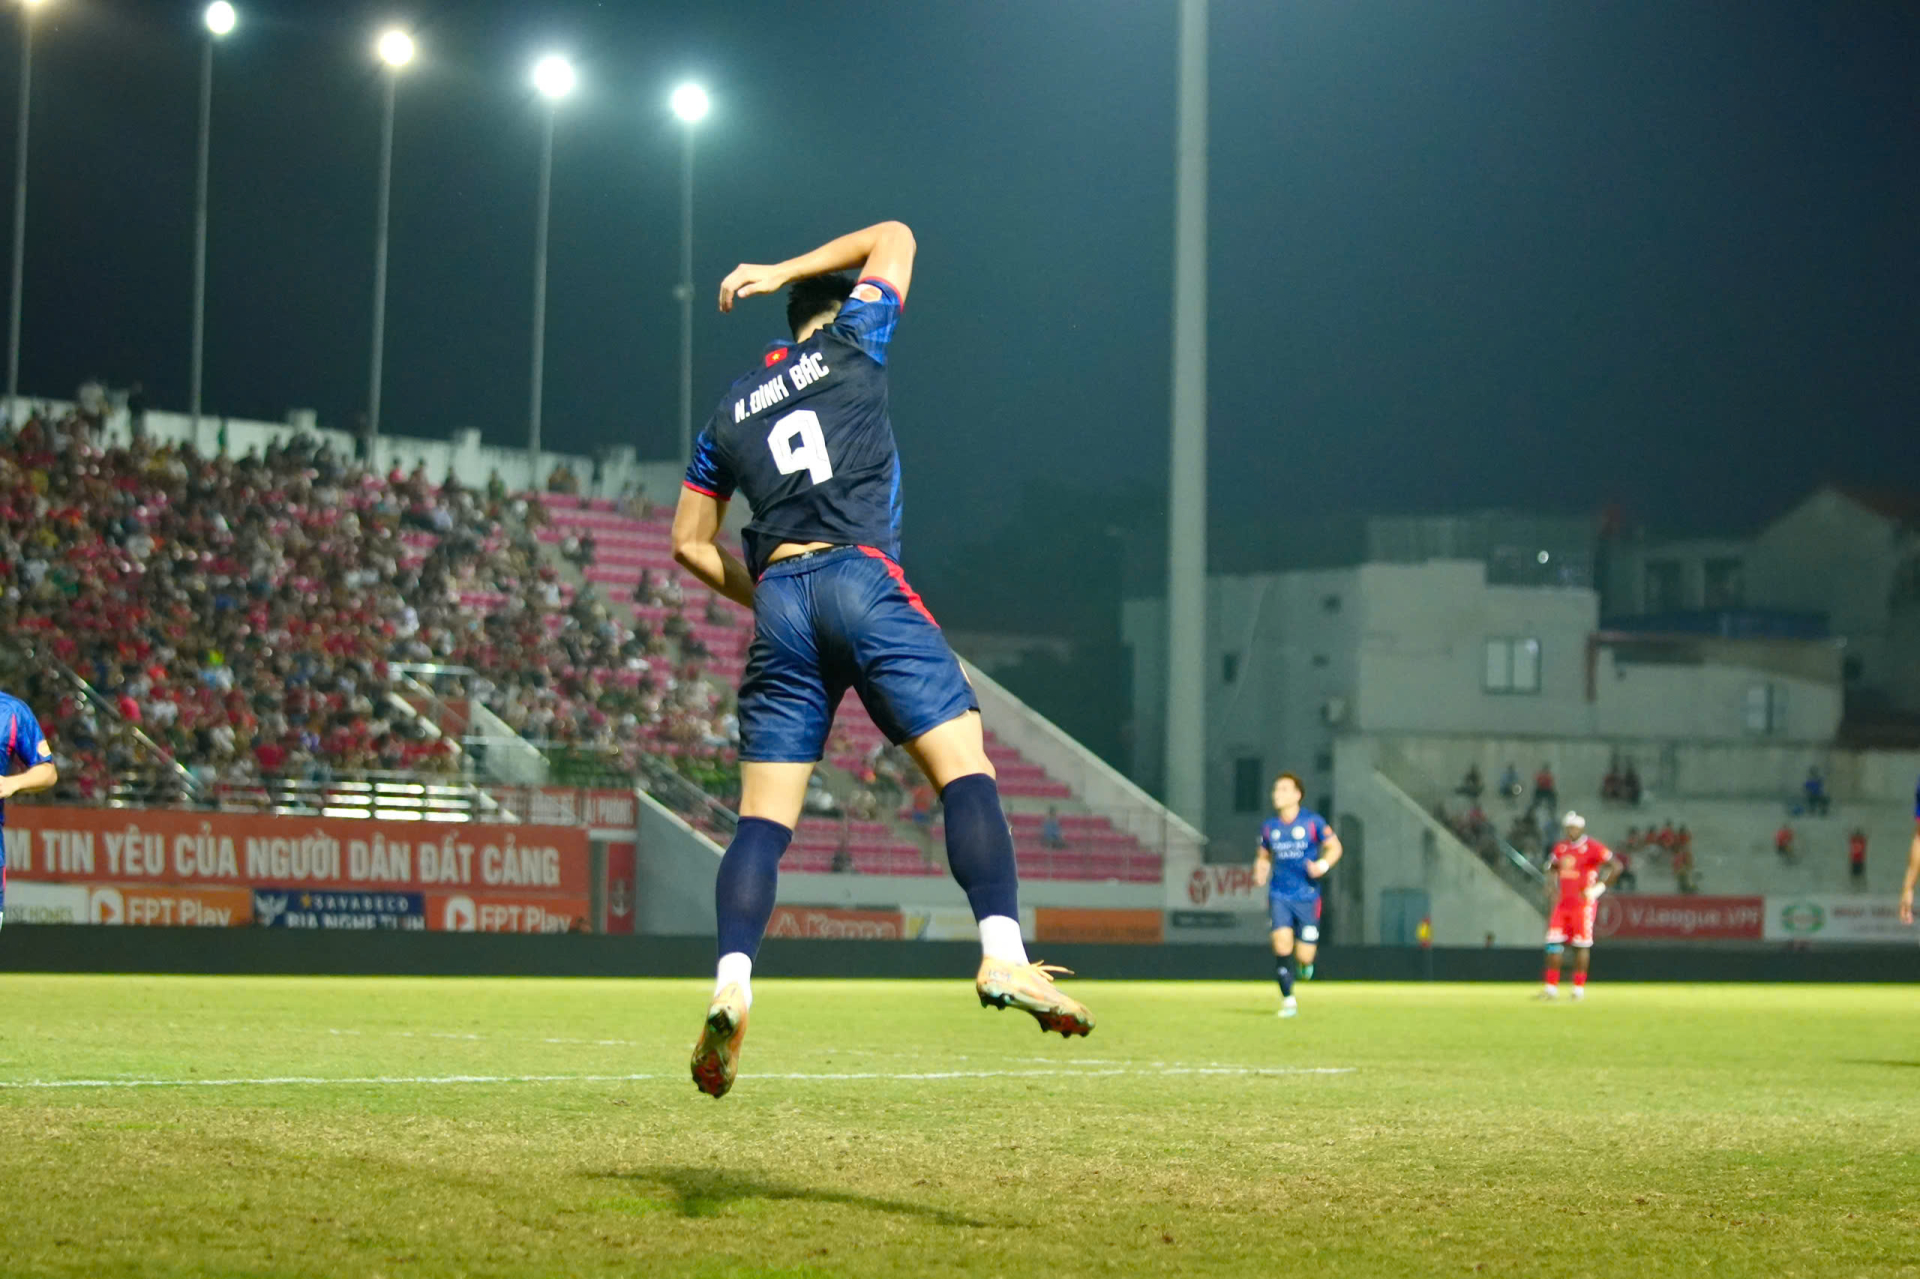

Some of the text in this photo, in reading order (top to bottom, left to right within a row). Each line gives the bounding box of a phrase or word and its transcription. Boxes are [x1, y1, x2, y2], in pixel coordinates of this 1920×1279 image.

[767, 409, 833, 485] 9
[40, 829, 94, 873] TIN
[105, 824, 165, 876] YÊU
[174, 821, 239, 877] CỦA
[245, 828, 341, 880] NGƯỜI
[348, 831, 411, 882] DÂN
[418, 829, 474, 884] ĐẤT
[481, 833, 561, 887] CẢNG
[129, 897, 232, 927] FPT Play
[479, 905, 572, 934] FPT Play
